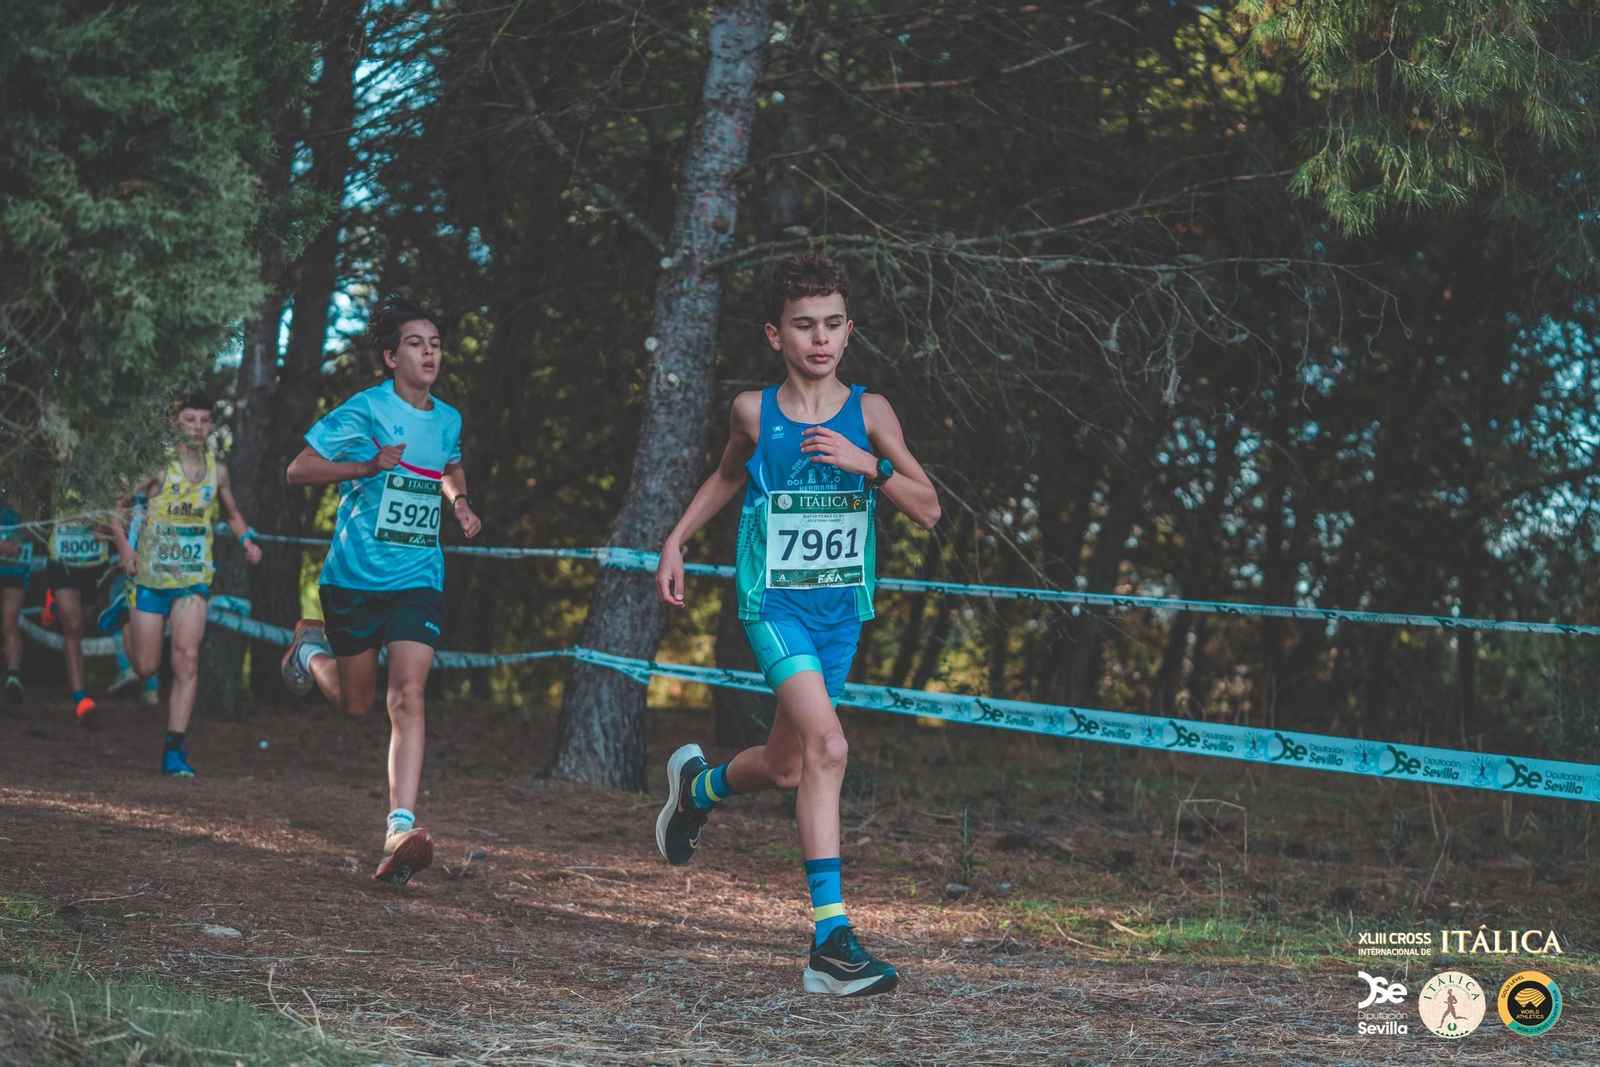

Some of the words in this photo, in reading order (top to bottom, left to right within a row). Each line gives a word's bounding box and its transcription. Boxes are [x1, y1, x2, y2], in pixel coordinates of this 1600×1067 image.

[787, 479, 803, 487] DOS
[799, 484, 838, 492] HERMANAS
[799, 494, 849, 507] ITÁLICA
[385, 500, 440, 530] 5920
[60, 540, 100, 554] 8000
[158, 542, 202, 561] 8002
[778, 527, 859, 562] 7961
[1201, 739, 1234, 753] Sevilla
[1308, 751, 1344, 768] Sevilla
[1424, 756, 1460, 768] Diputación
[1422, 765, 1459, 780] Sevilla
[1545, 769, 1584, 783] Diputación
[1543, 779, 1584, 794] Sevilla
